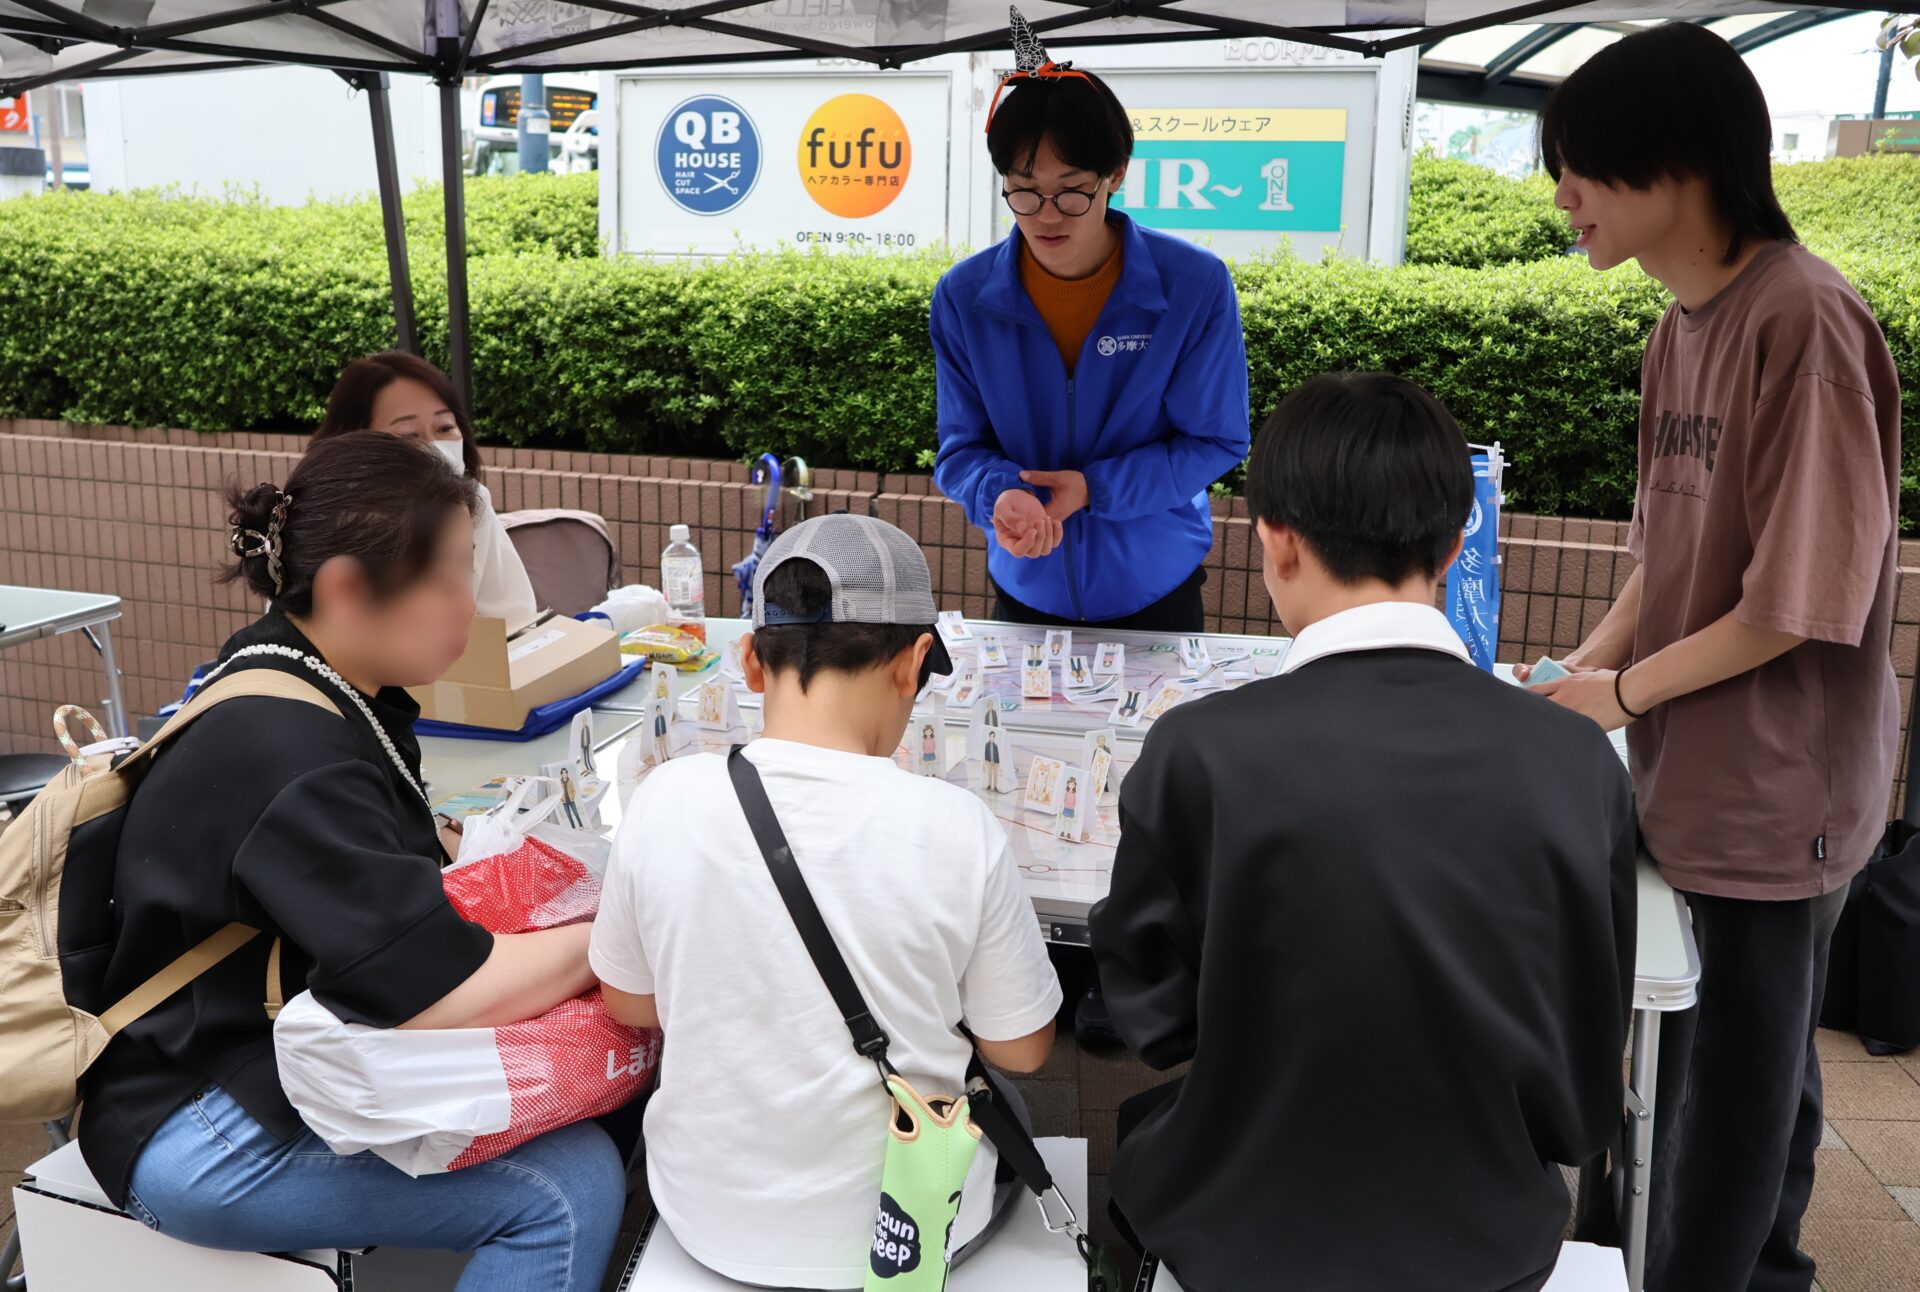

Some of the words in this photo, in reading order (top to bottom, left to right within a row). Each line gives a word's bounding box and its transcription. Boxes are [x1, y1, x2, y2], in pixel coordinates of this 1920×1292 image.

[674, 111, 741, 150] QB
[675, 152, 741, 168] HOUSE
[675, 171, 695, 179] HAIR
[807, 175, 901, 187] ヘアカラー専門店
[675, 179, 692, 187] CUT
[1270, 165, 1286, 206] ONE
[675, 187, 700, 195] SPACE
[877, 232, 915, 246] 18:00
[1117, 340, 1149, 352] 多摩大
[877, 1206, 915, 1241] aun
[873, 1234, 911, 1267] eep
